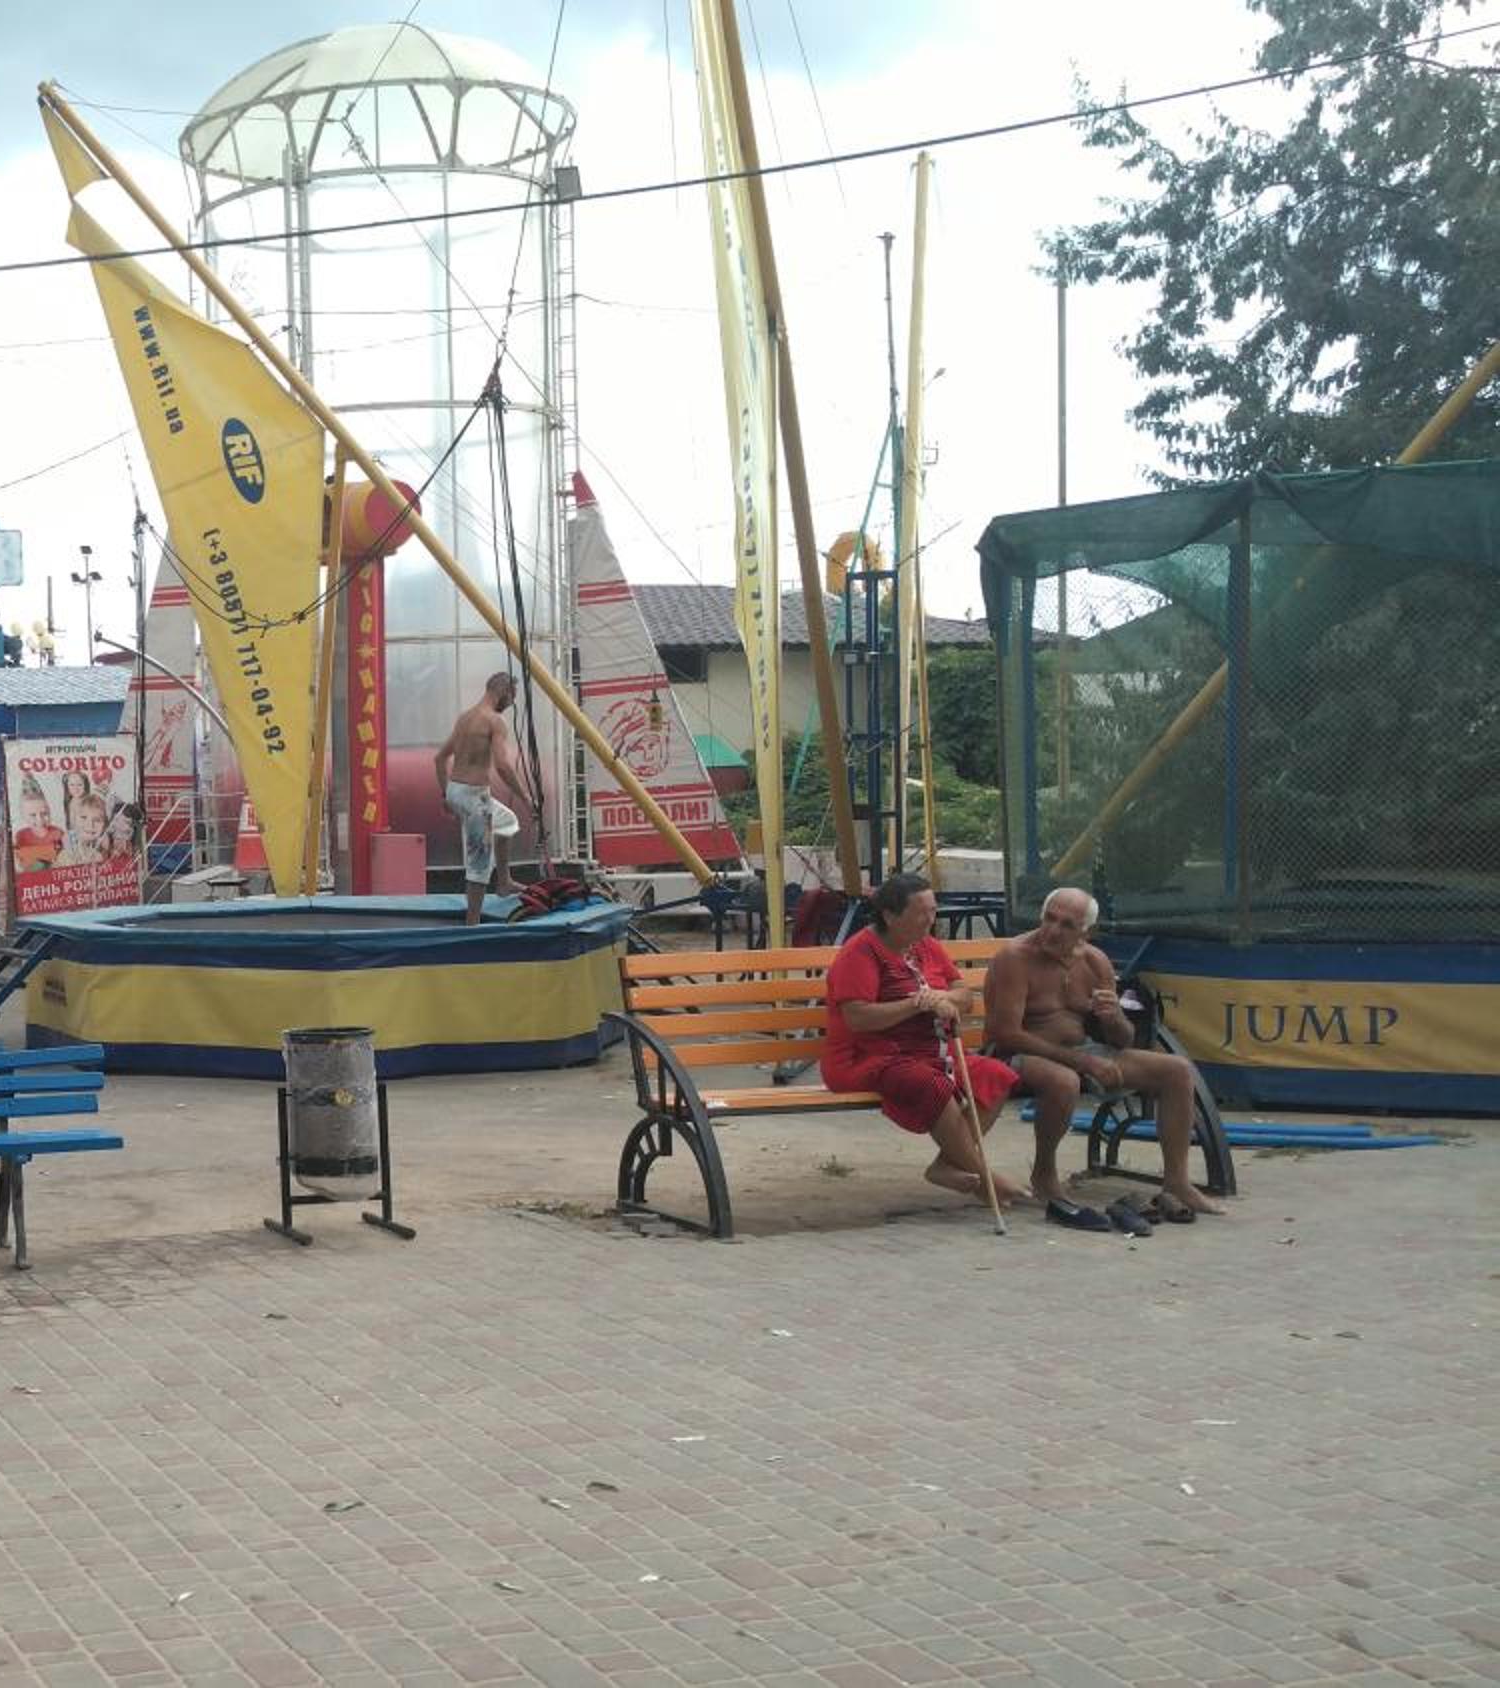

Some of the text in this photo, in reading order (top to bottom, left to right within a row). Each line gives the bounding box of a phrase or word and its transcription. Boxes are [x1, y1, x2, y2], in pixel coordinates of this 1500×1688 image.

[225, 434, 263, 486] RIF
[18, 755, 125, 772] COLORITO
[601, 801, 709, 826] ПОЕАЛИ!
[22, 883, 60, 901] ДЕНЬ
[1221, 1003, 1398, 1048] JUMP
